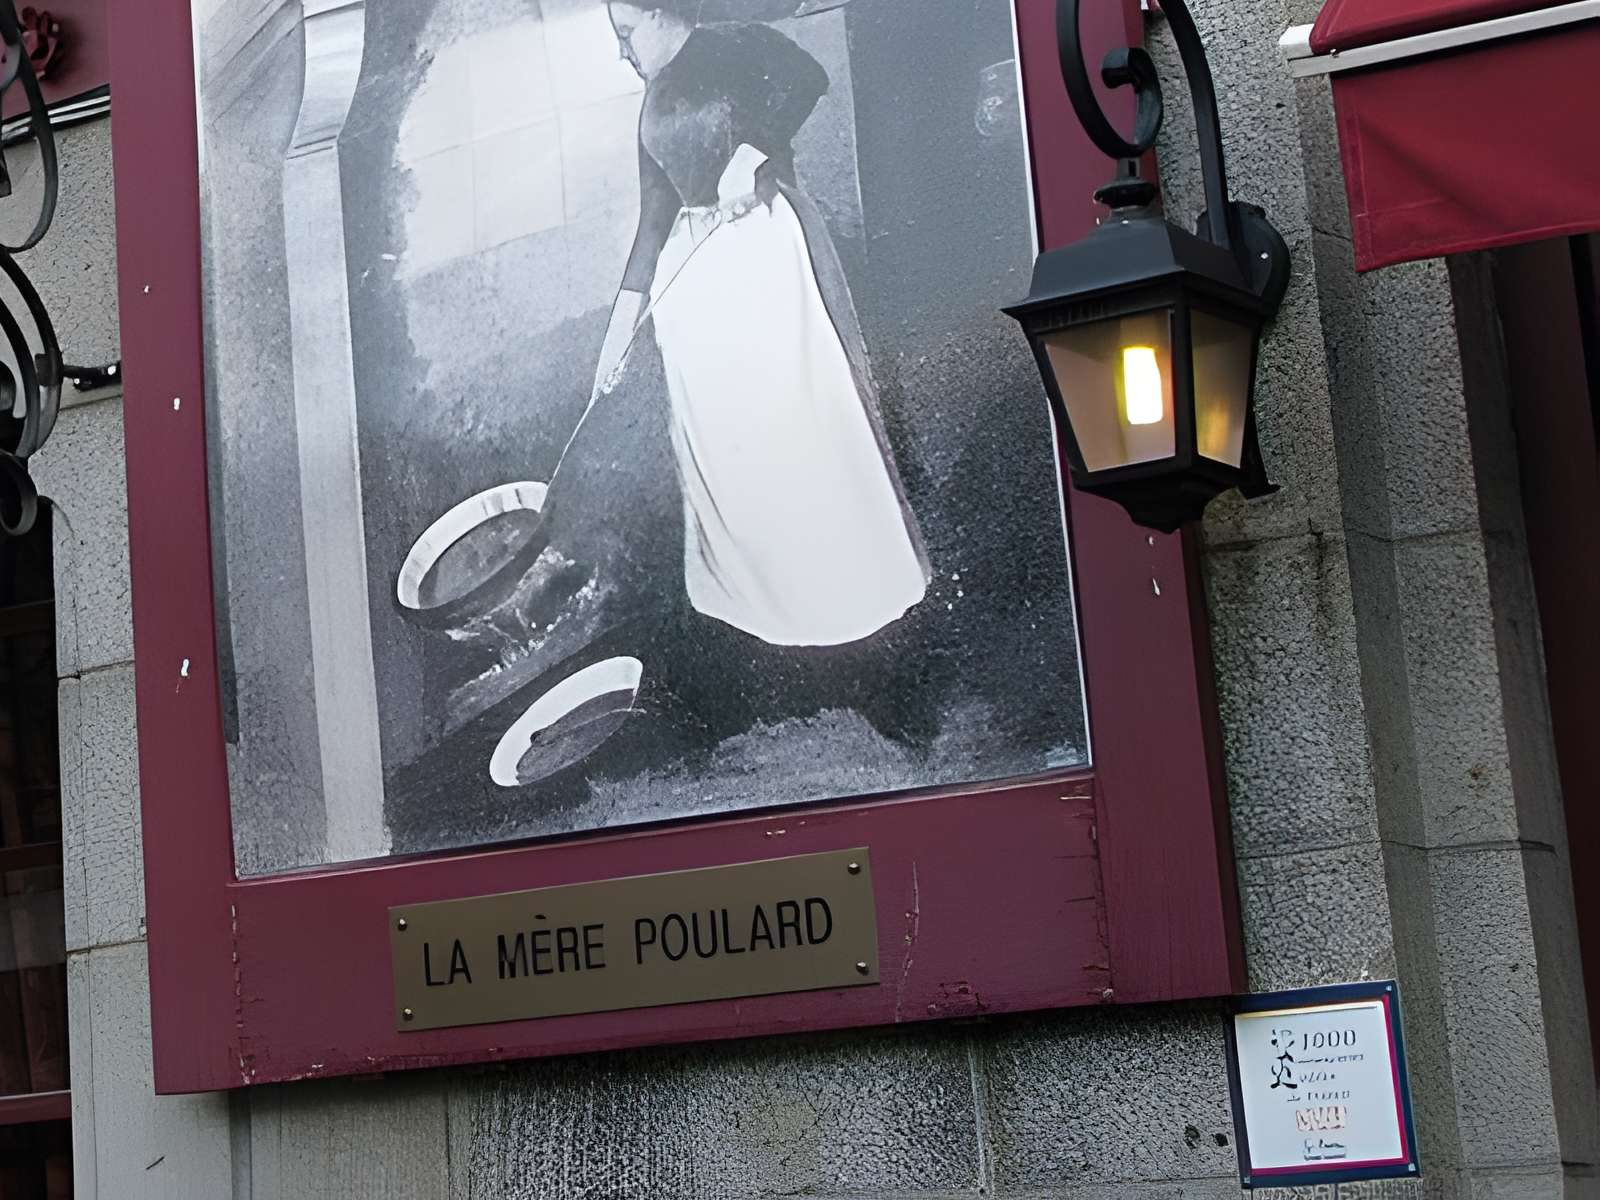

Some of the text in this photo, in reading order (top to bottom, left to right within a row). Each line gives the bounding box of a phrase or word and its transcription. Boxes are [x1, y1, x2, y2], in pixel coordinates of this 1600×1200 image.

[422, 896, 834, 988] LA MÈRE POULARD
